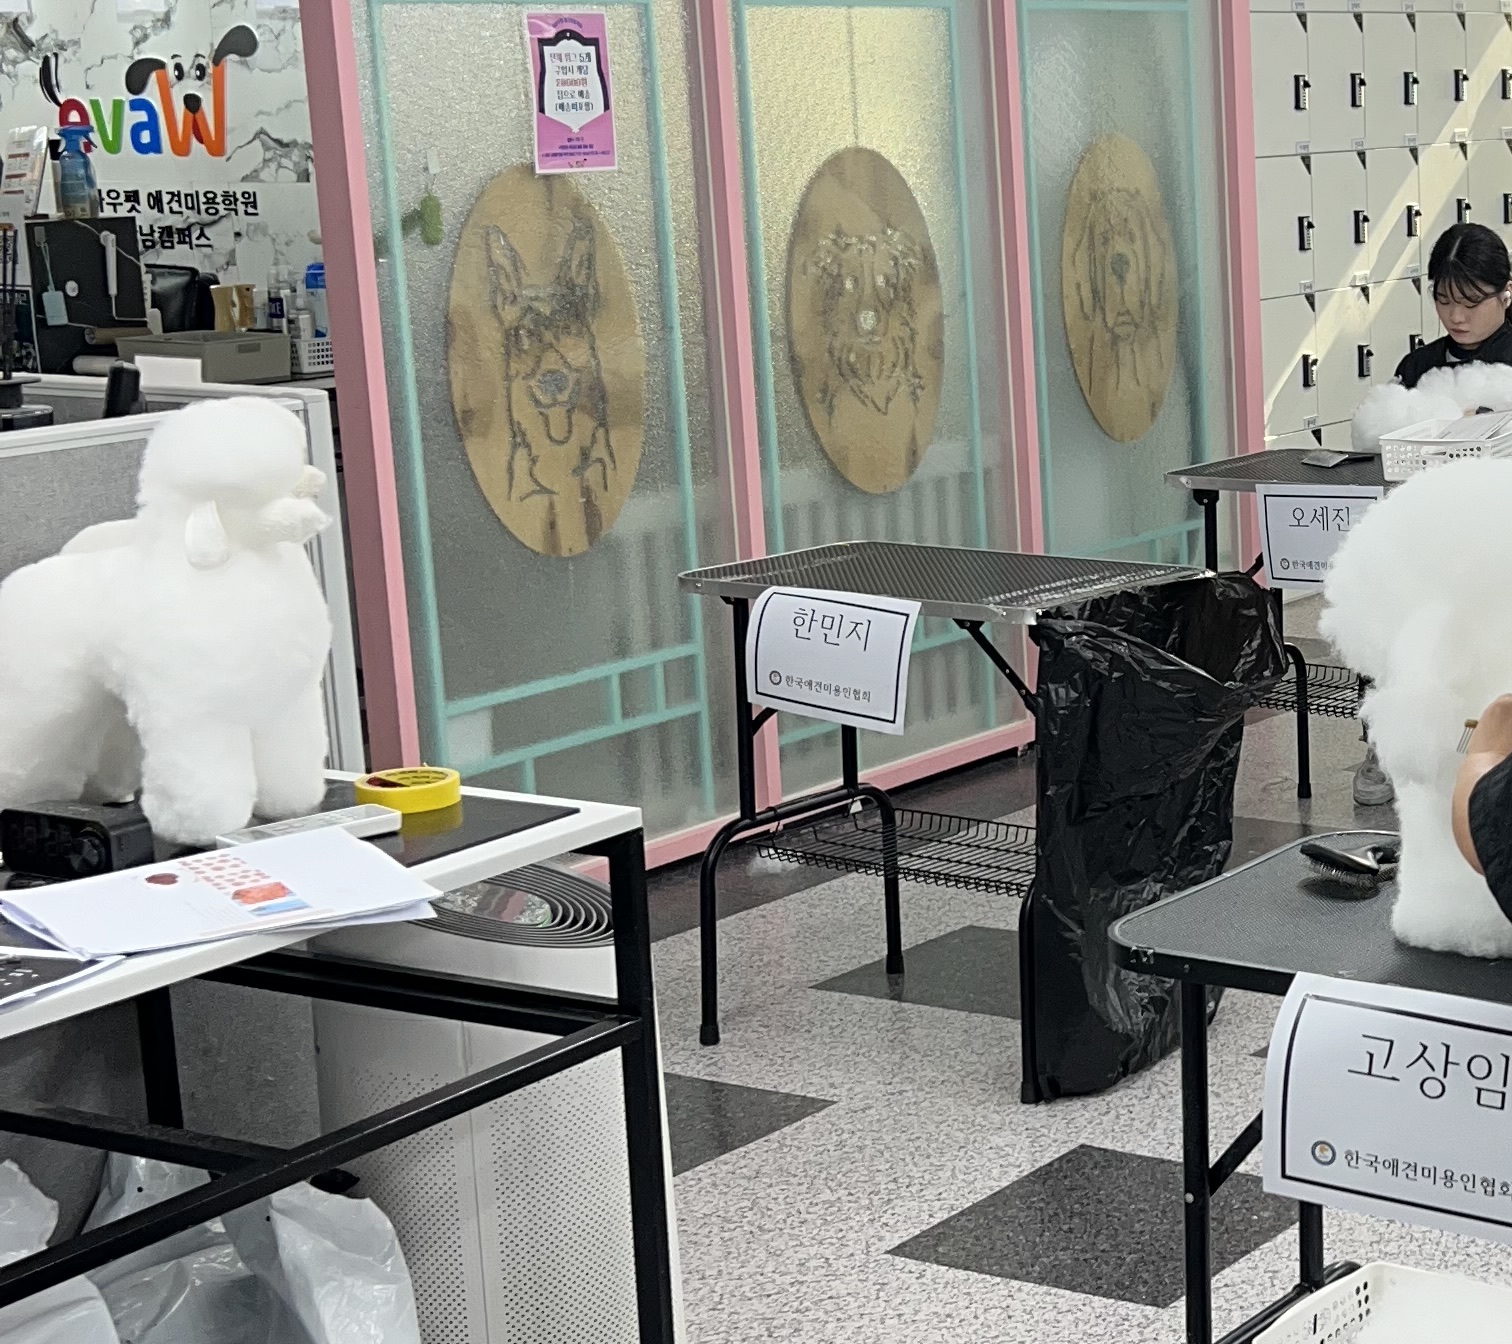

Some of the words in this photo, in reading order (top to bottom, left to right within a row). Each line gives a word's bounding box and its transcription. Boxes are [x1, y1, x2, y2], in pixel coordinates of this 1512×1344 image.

[147, 189, 259, 216] 애견미용학원
[1288, 505, 1351, 532] 오세진
[793, 607, 872, 652] 한민지
[785, 674, 871, 703] 한국애견미용인협회
[1347, 1033, 1511, 1111] 고상임
